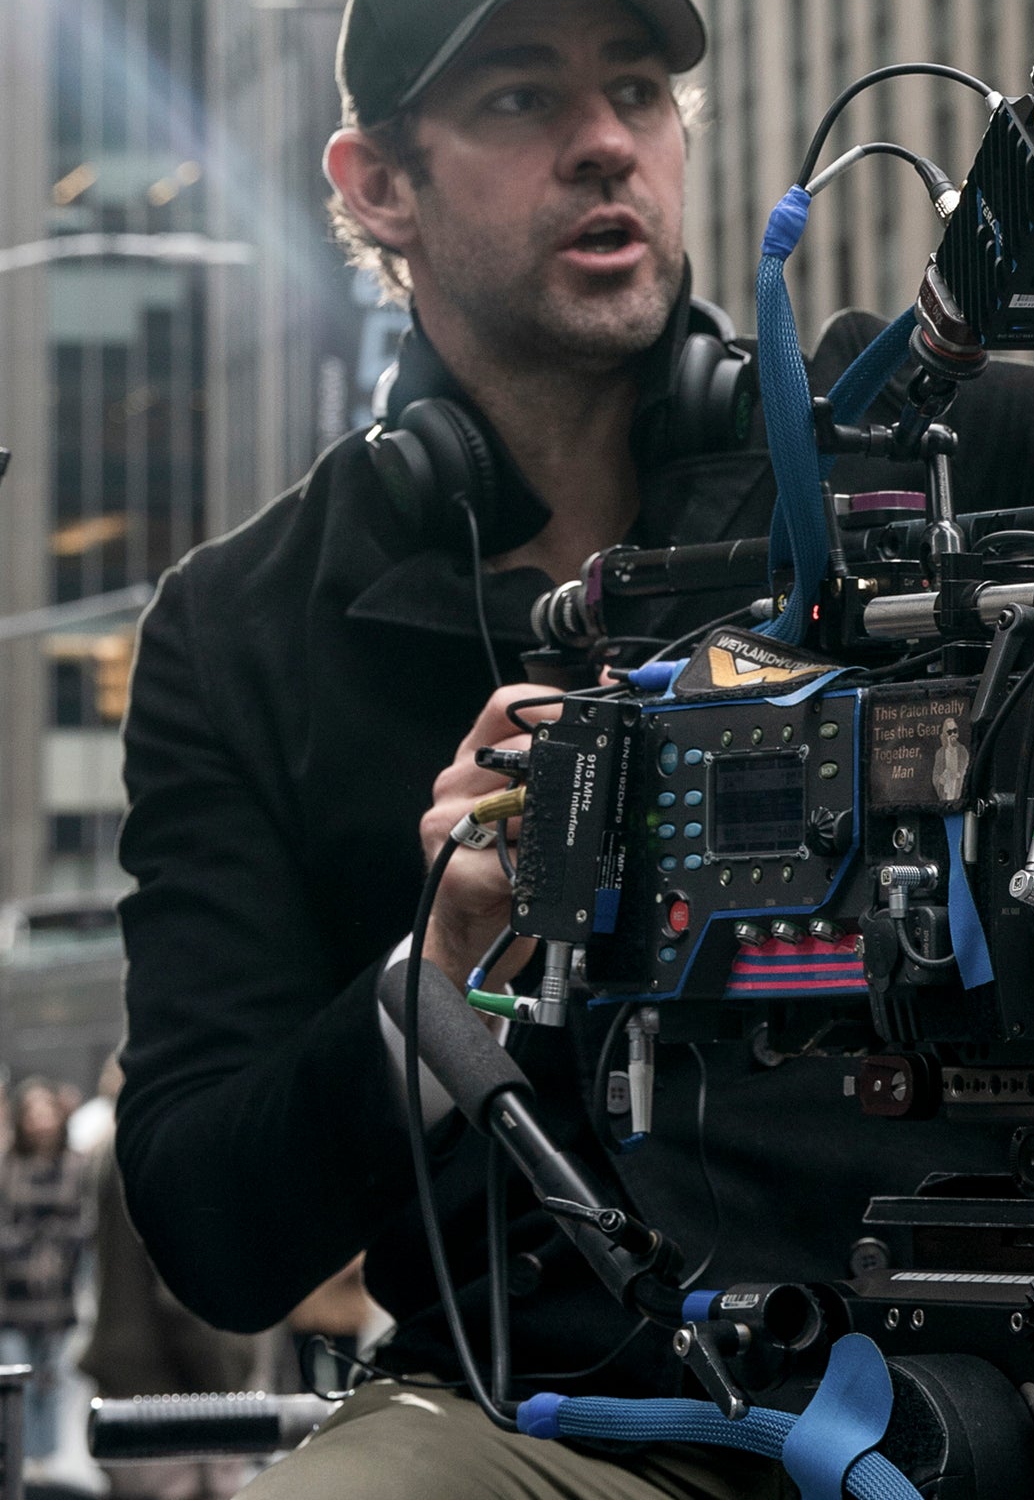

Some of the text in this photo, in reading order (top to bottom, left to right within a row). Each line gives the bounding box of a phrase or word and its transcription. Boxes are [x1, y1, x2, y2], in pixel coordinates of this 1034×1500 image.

[874, 699, 966, 721] This Patch Really
[873, 722, 943, 742] Ties the Gear
[873, 745, 923, 764] Together,
[581, 753, 597, 812] 915 MHz
[891, 765, 915, 779] Man
[566, 752, 587, 848] Alexa Interface
